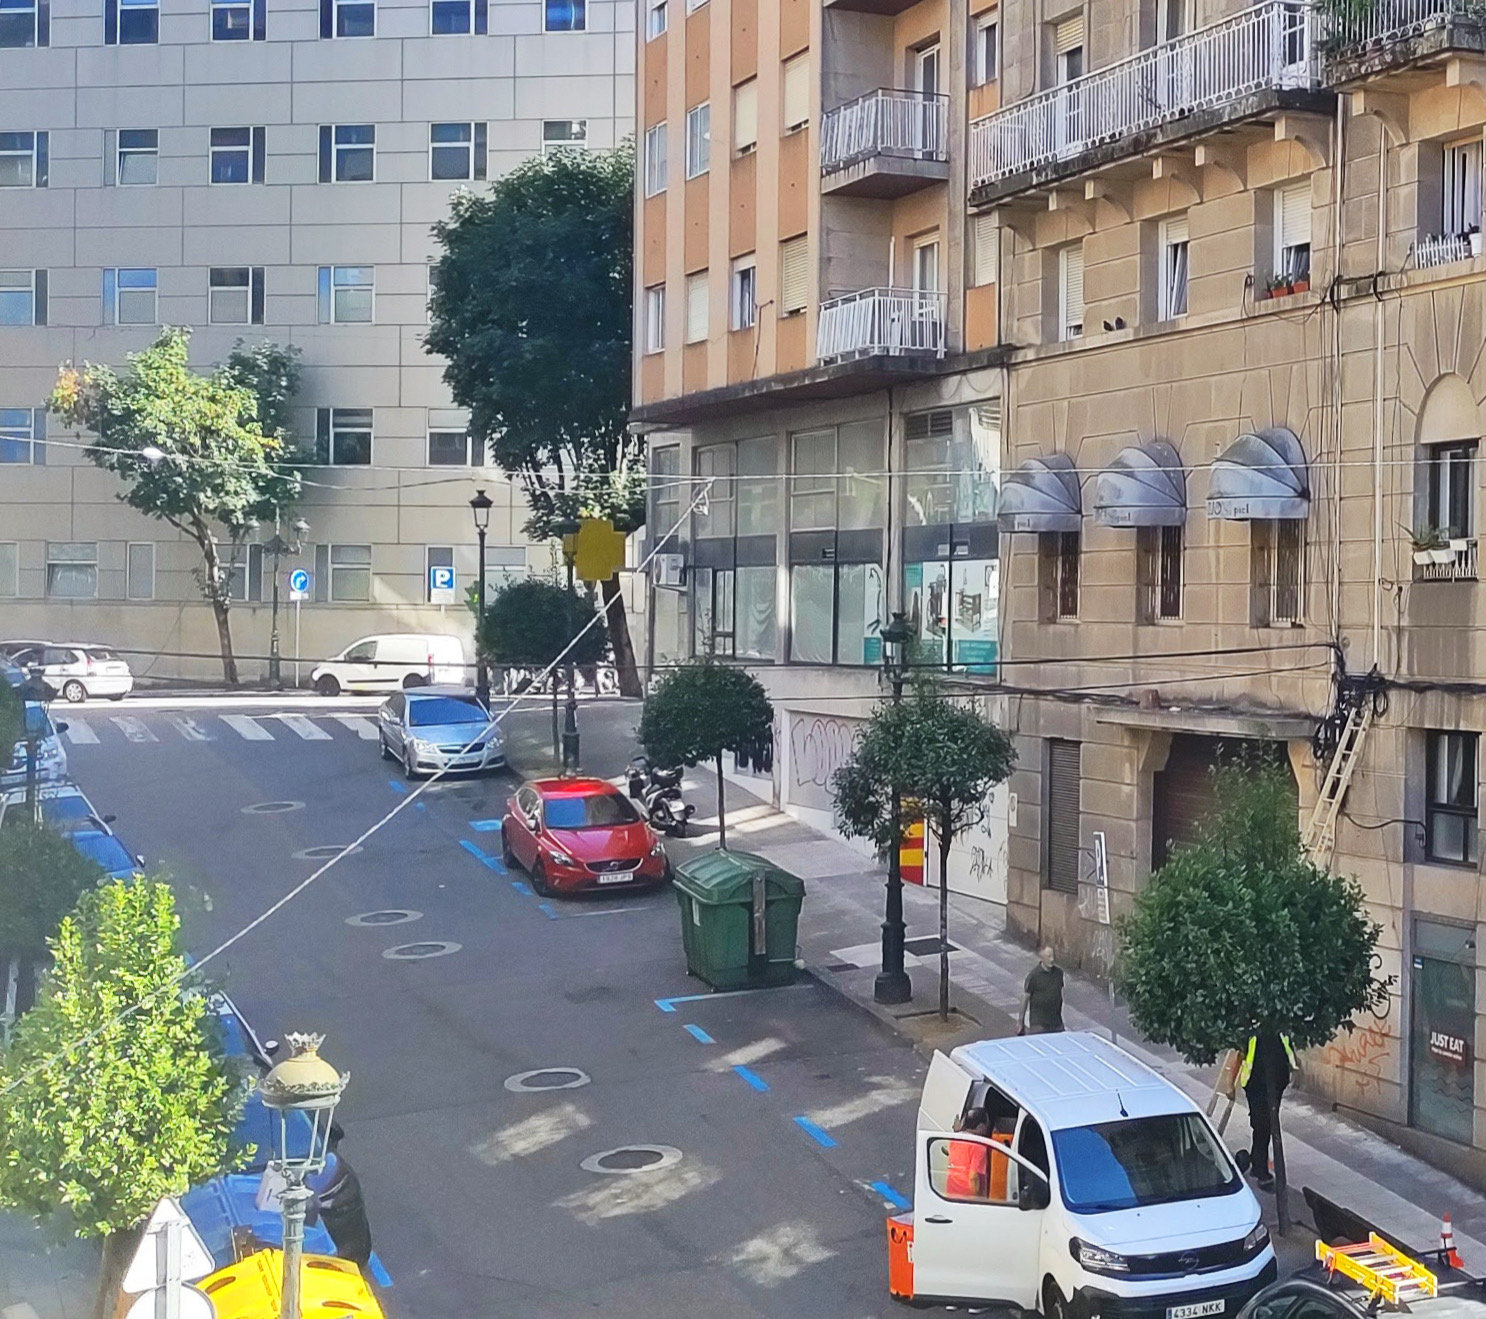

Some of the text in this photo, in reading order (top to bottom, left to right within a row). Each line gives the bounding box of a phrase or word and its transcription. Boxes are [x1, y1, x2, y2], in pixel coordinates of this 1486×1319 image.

[436, 569, 451, 587] P
[1430, 1031, 1464, 1053] JUST EAT
[1173, 1302, 1221, 1318] 4334 NKK
